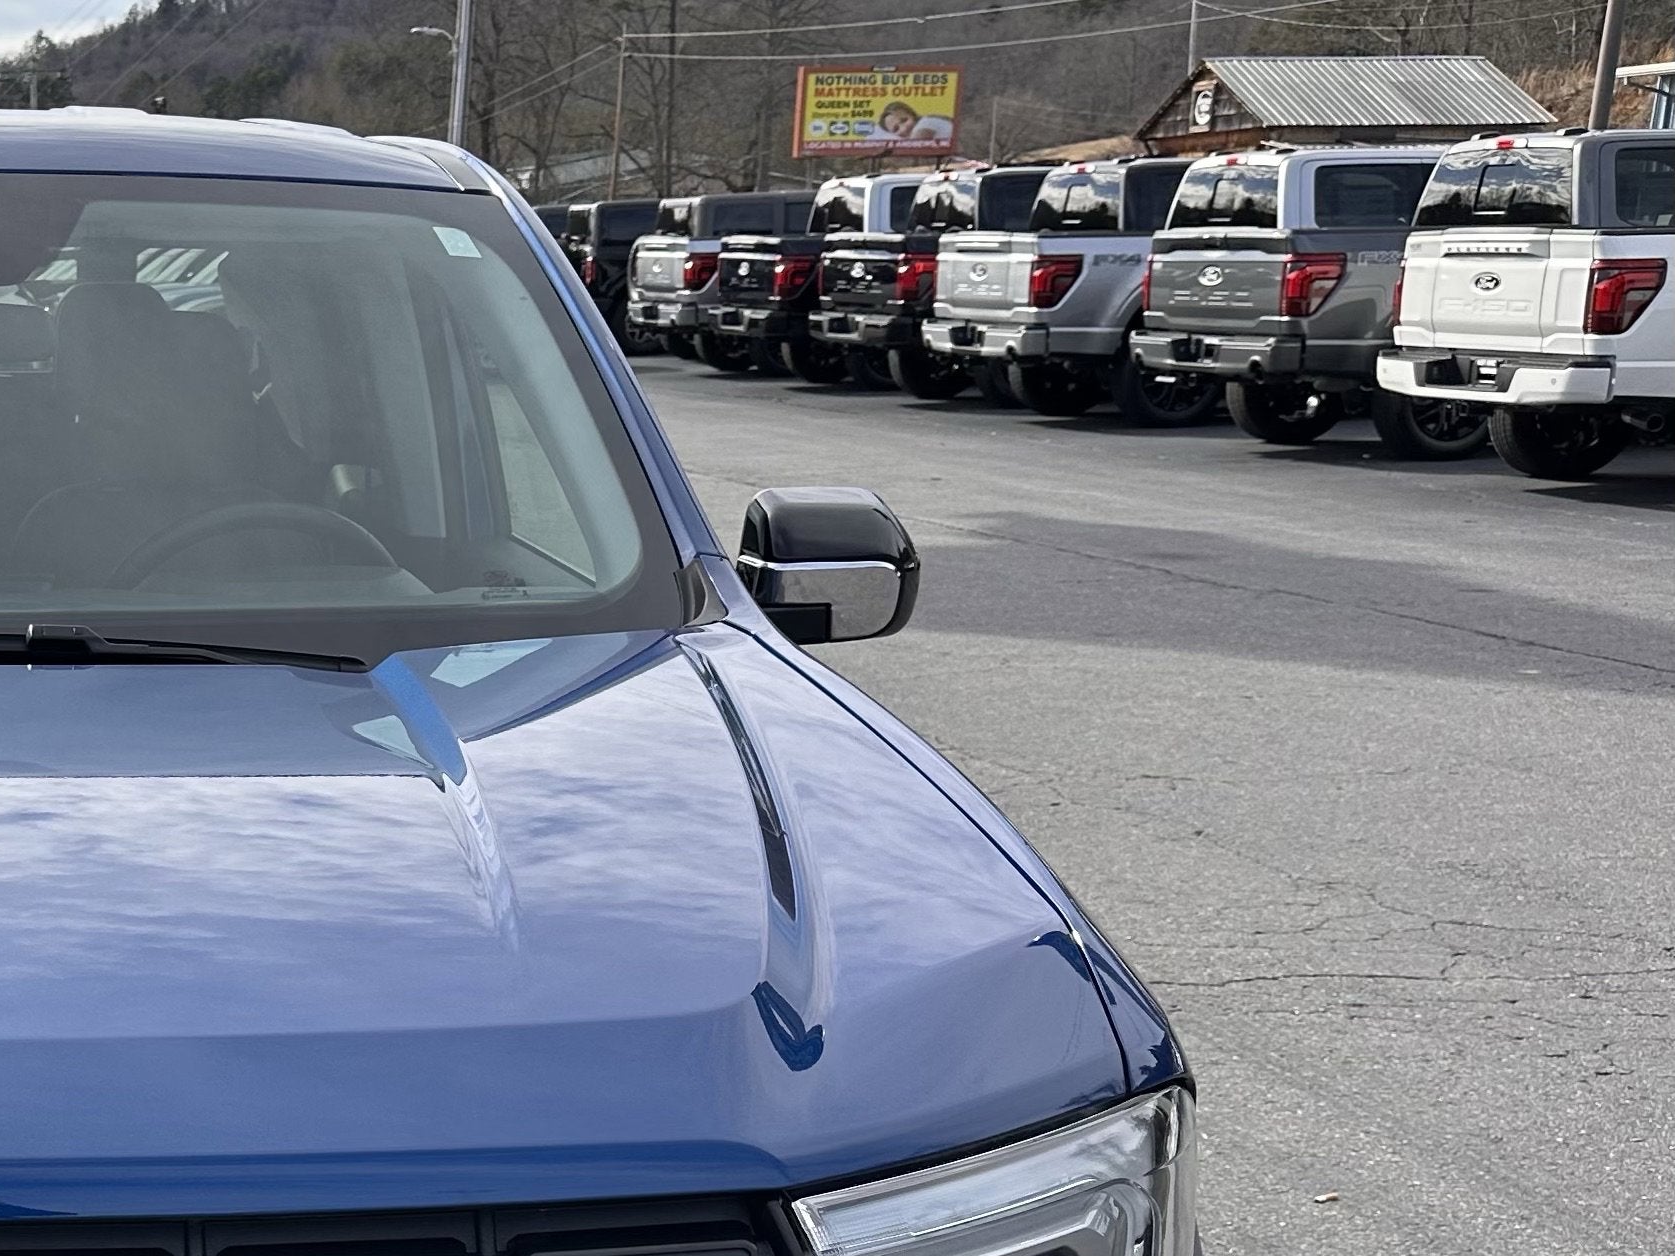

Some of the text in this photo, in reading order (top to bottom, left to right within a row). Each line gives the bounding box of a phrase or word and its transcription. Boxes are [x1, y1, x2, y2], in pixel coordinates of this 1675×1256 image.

[815, 74, 948, 85] NOTHING BUT BEDS
[814, 86, 948, 97] MATTRESS OUTLET
[815, 100, 871, 109] QUEEN SET
